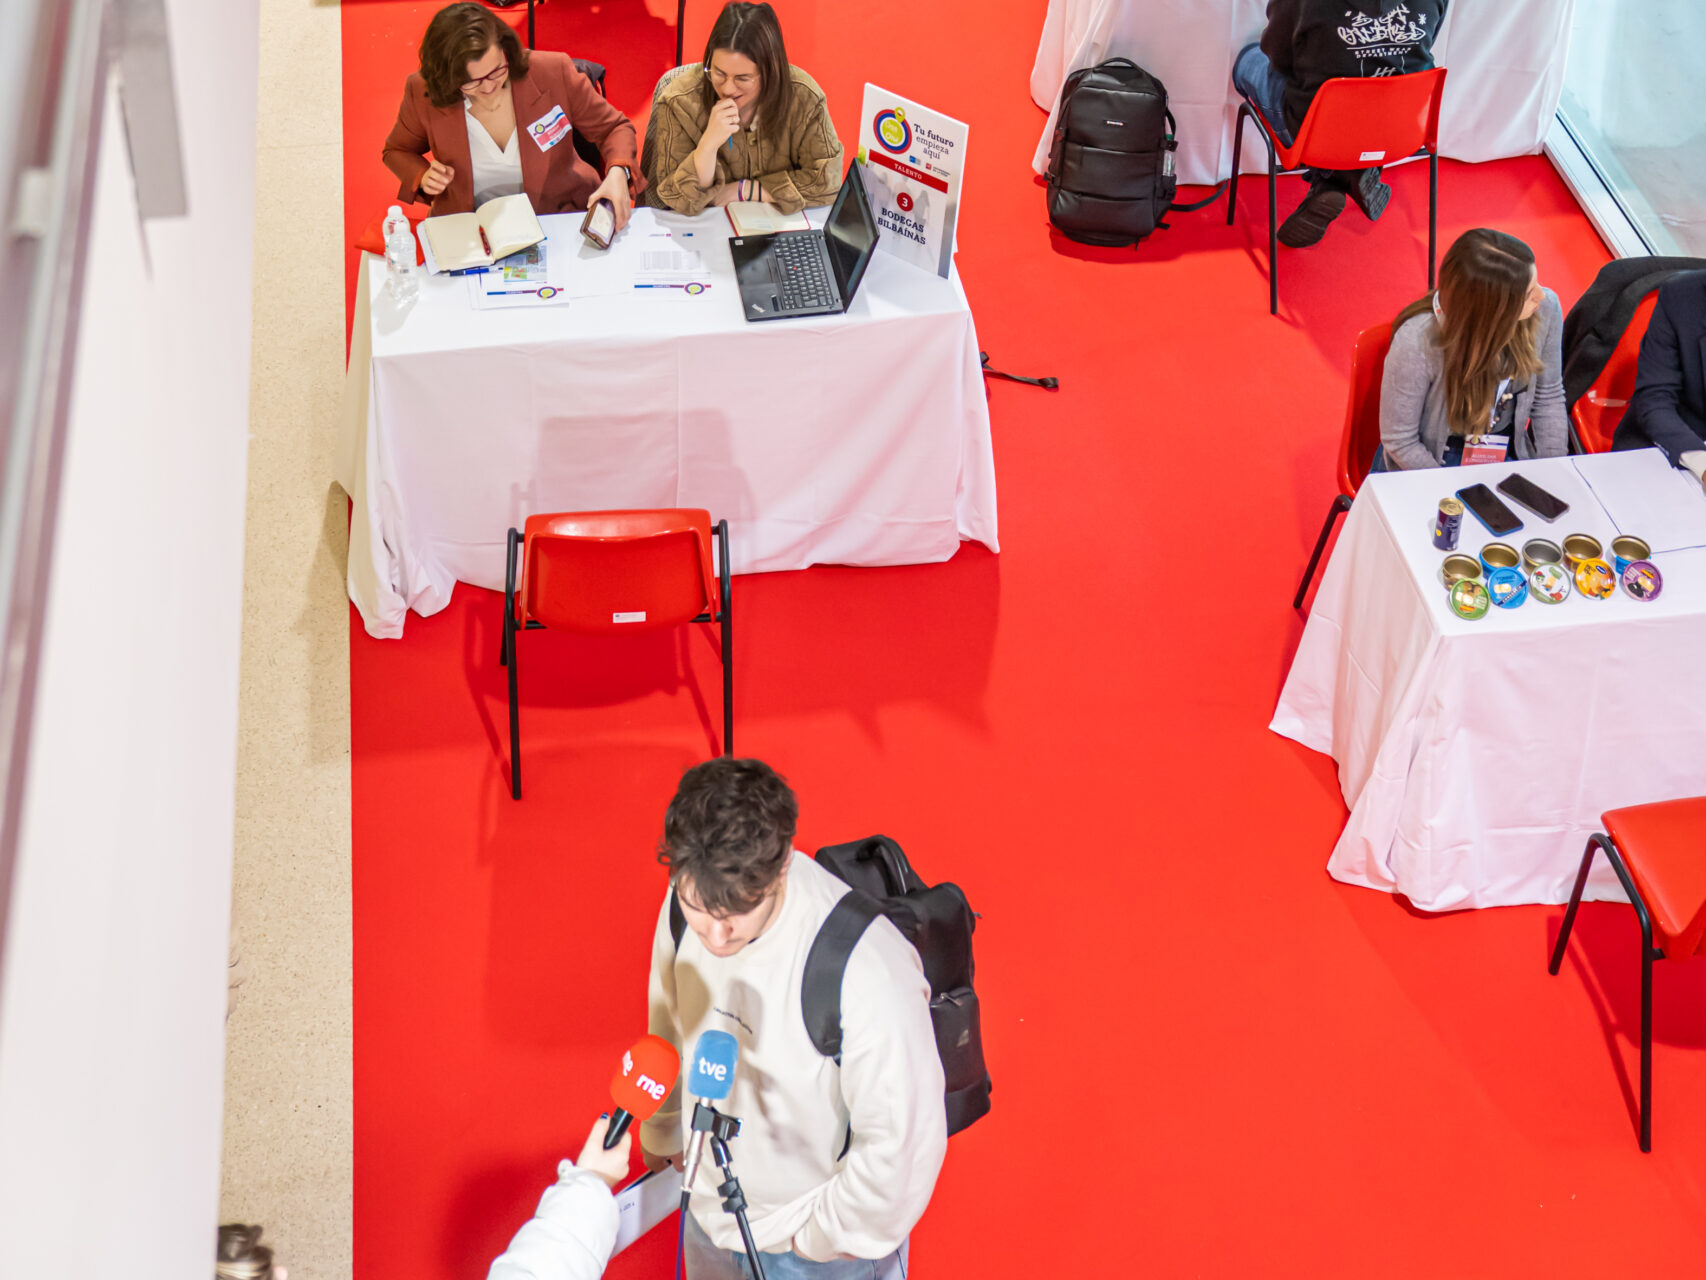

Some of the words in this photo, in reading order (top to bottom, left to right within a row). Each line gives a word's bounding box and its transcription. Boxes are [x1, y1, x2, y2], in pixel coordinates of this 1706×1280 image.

[914, 123, 926, 136] Tu
[927, 129, 954, 148] futuro
[916, 135, 949, 155] empieza
[894, 163, 922, 180] TALENTO
[902, 197, 908, 208] 3
[877, 216, 926, 245] BILBAÍNAS
[881, 207, 924, 233] BODEGAS
[698, 1056, 727, 1081] tve
